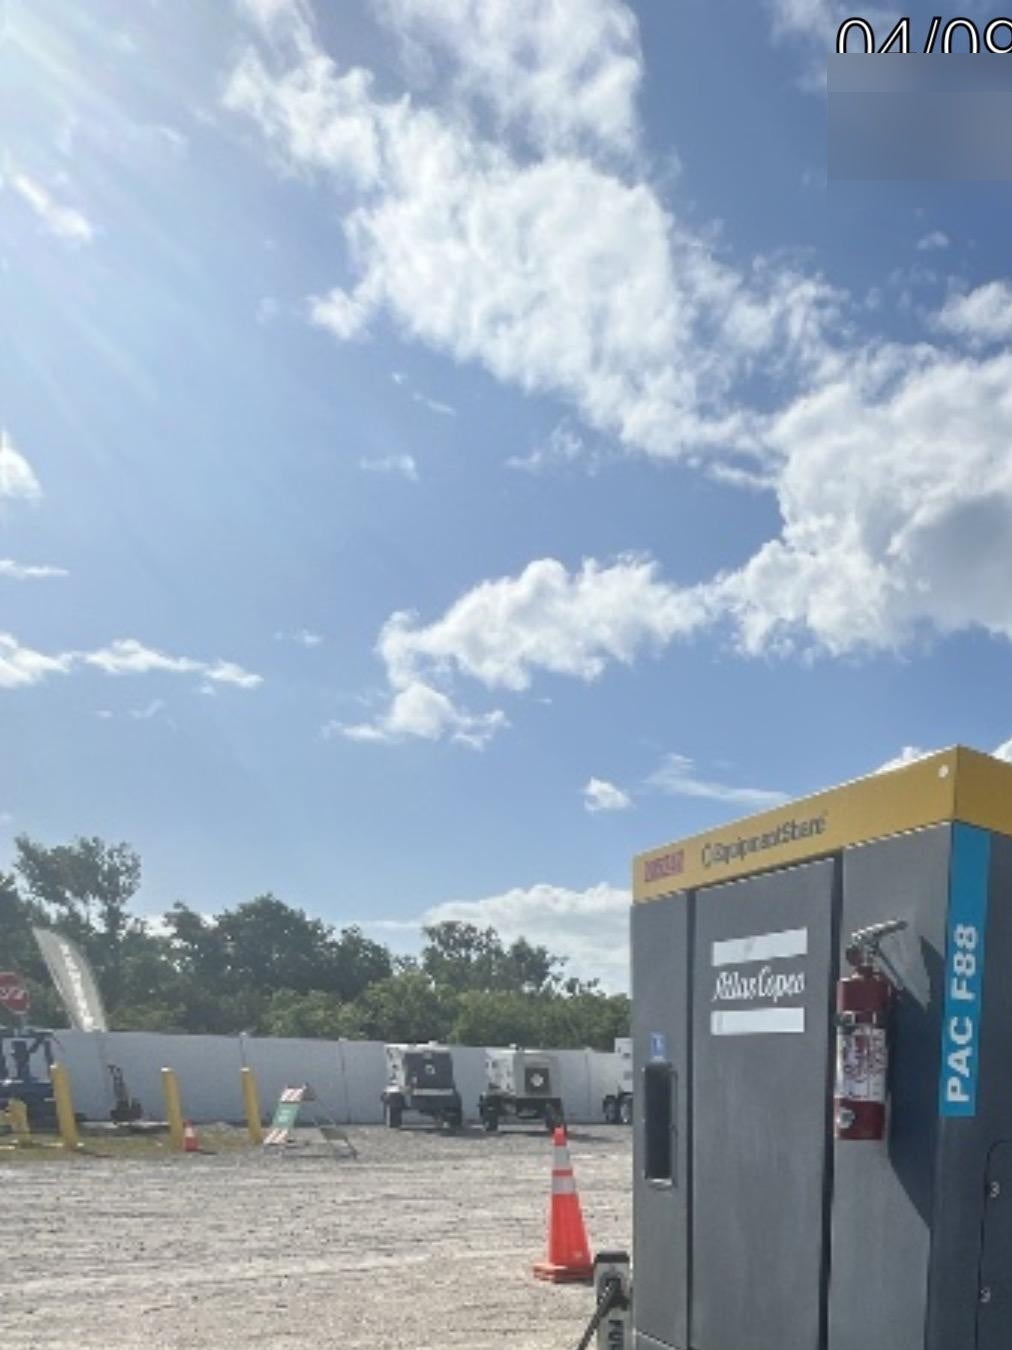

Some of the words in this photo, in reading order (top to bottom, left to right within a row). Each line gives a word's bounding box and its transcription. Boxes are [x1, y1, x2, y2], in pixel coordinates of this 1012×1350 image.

[711, 970, 757, 1001] Atlas
[758, 964, 805, 1003] Copco
[951, 923, 979, 1001] F88
[946, 1015, 974, 1103] PAC
